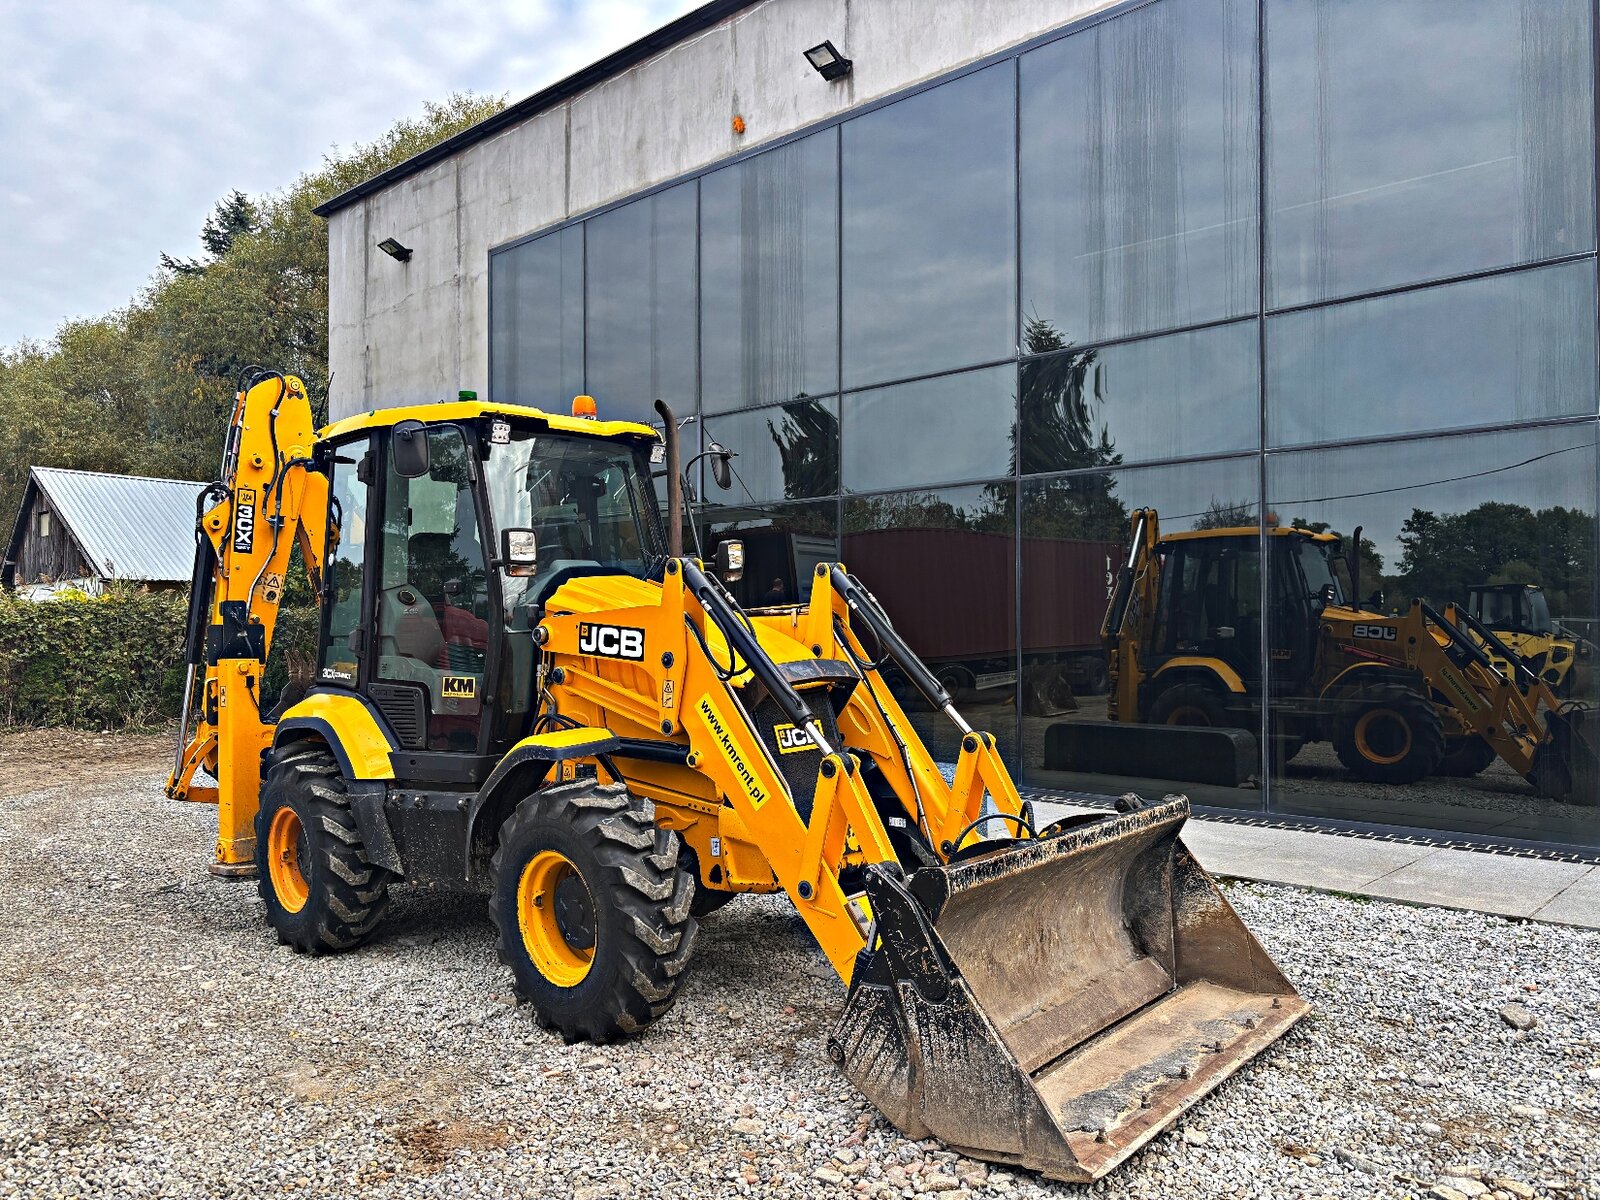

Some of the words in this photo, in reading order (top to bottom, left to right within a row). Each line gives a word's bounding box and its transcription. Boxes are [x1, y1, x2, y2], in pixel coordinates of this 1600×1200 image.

[235, 505, 253, 543] 3CX
[580, 626, 643, 657] JCB
[444, 678, 474, 693] KM
[700, 699, 764, 803] www.kmrent.pl
